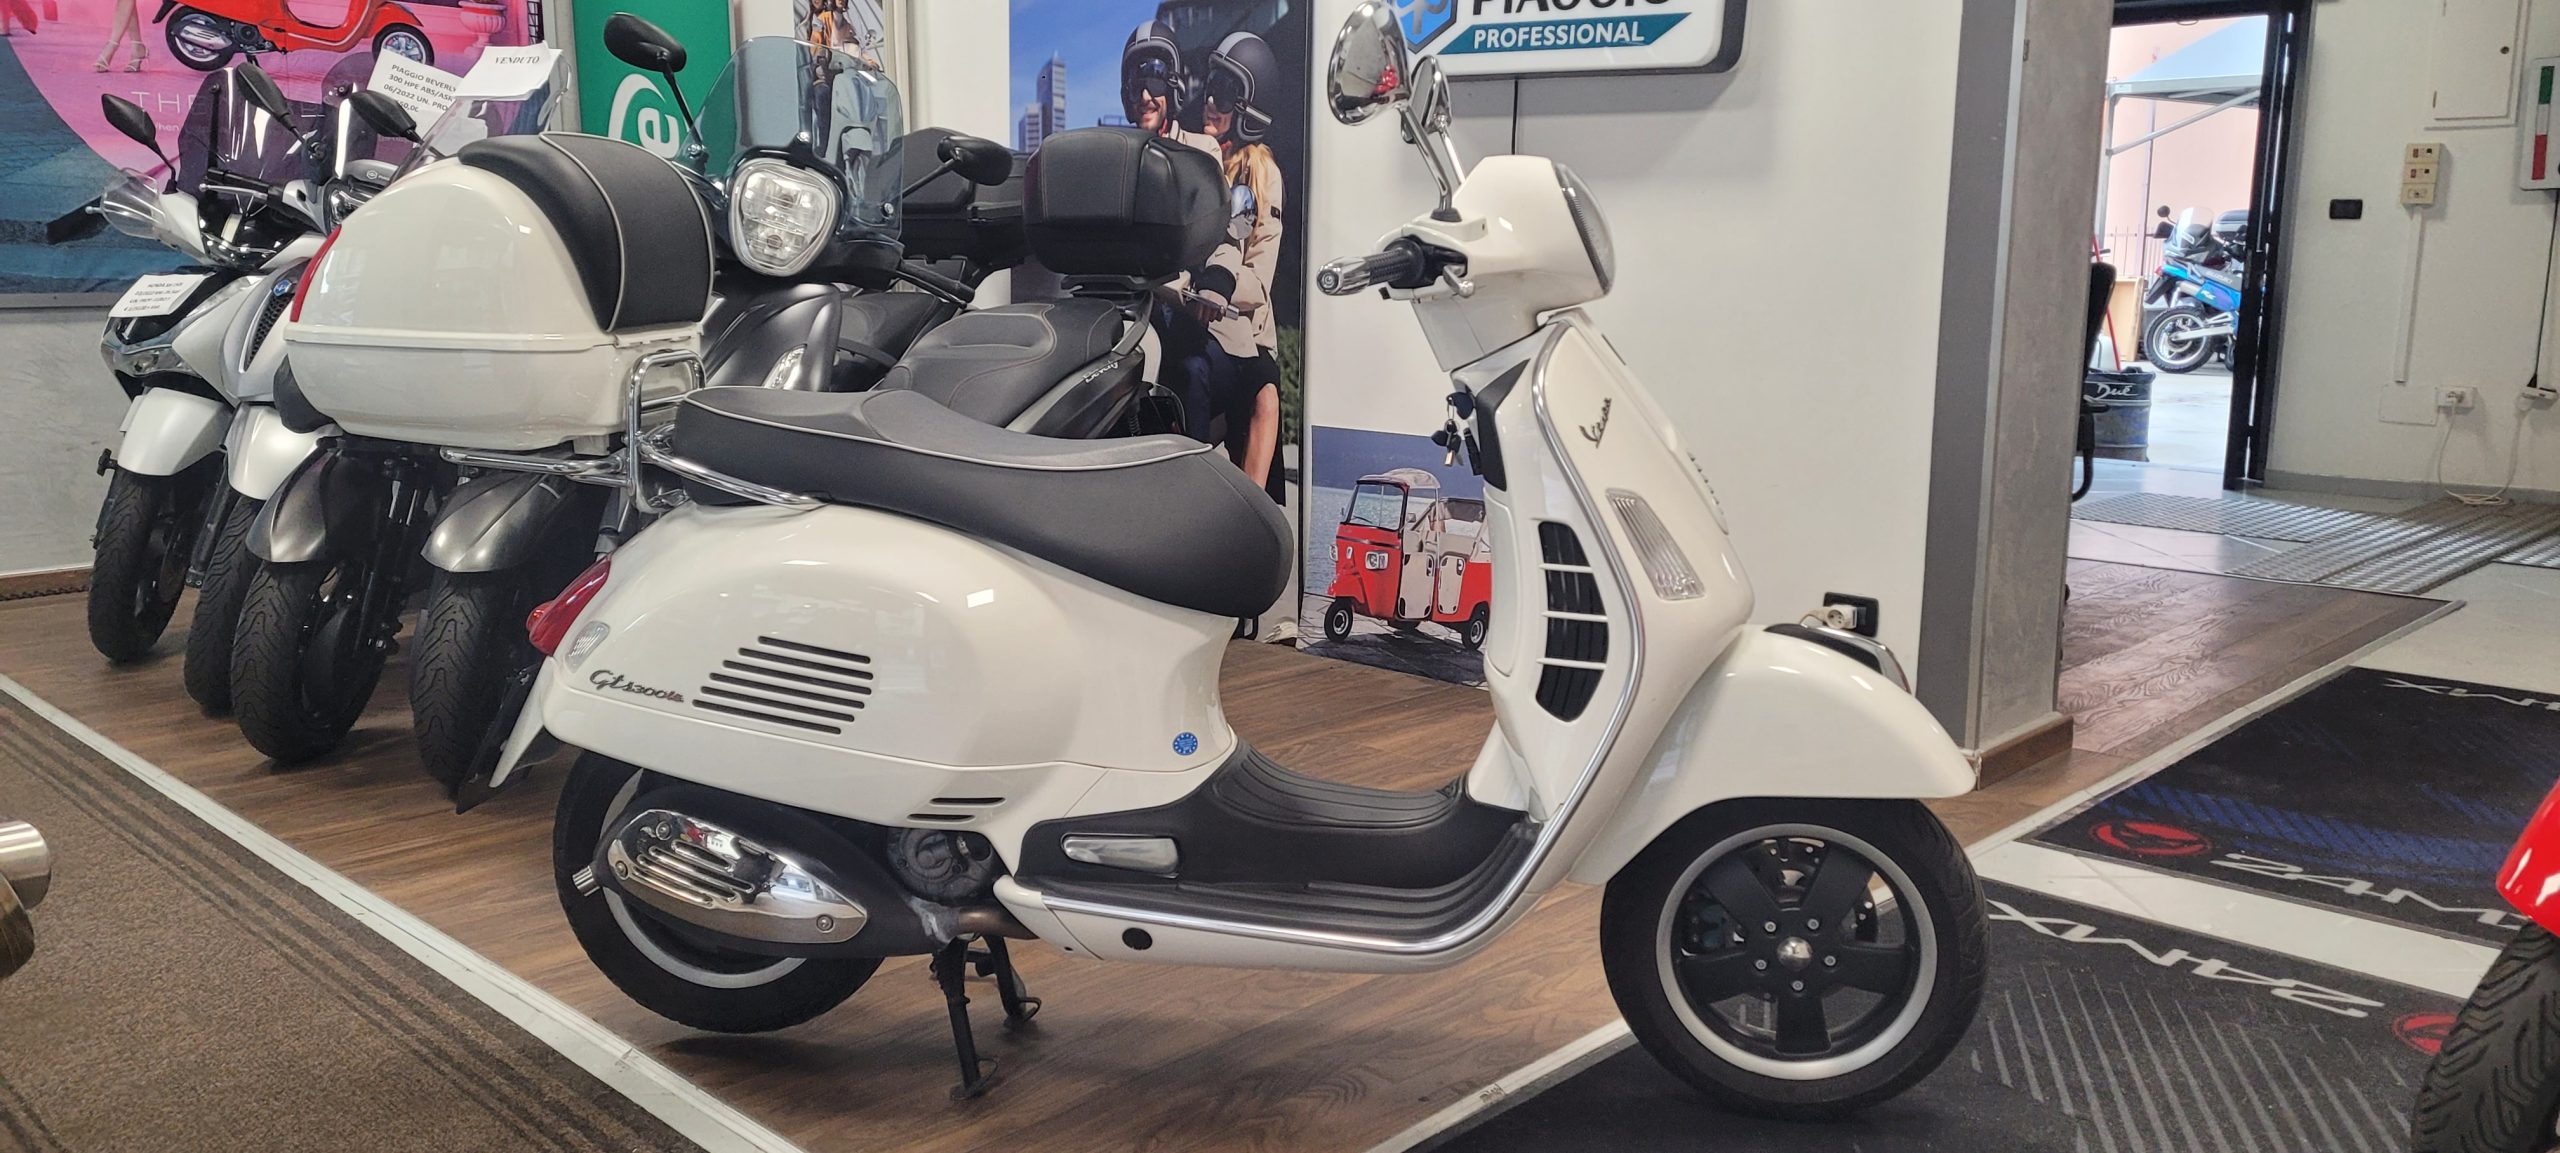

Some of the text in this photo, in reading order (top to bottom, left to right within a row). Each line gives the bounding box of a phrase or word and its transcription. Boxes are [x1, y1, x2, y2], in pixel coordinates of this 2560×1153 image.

[1473, 21, 1645, 49] PROFESSIONAL
[495, 55, 540, 65] VENDUTO
[391, 64, 425, 81] PIAGGIO
[388, 73, 404, 84] 300
[404, 80, 420, 90] HPE
[383, 83, 416, 99] 06/2022
